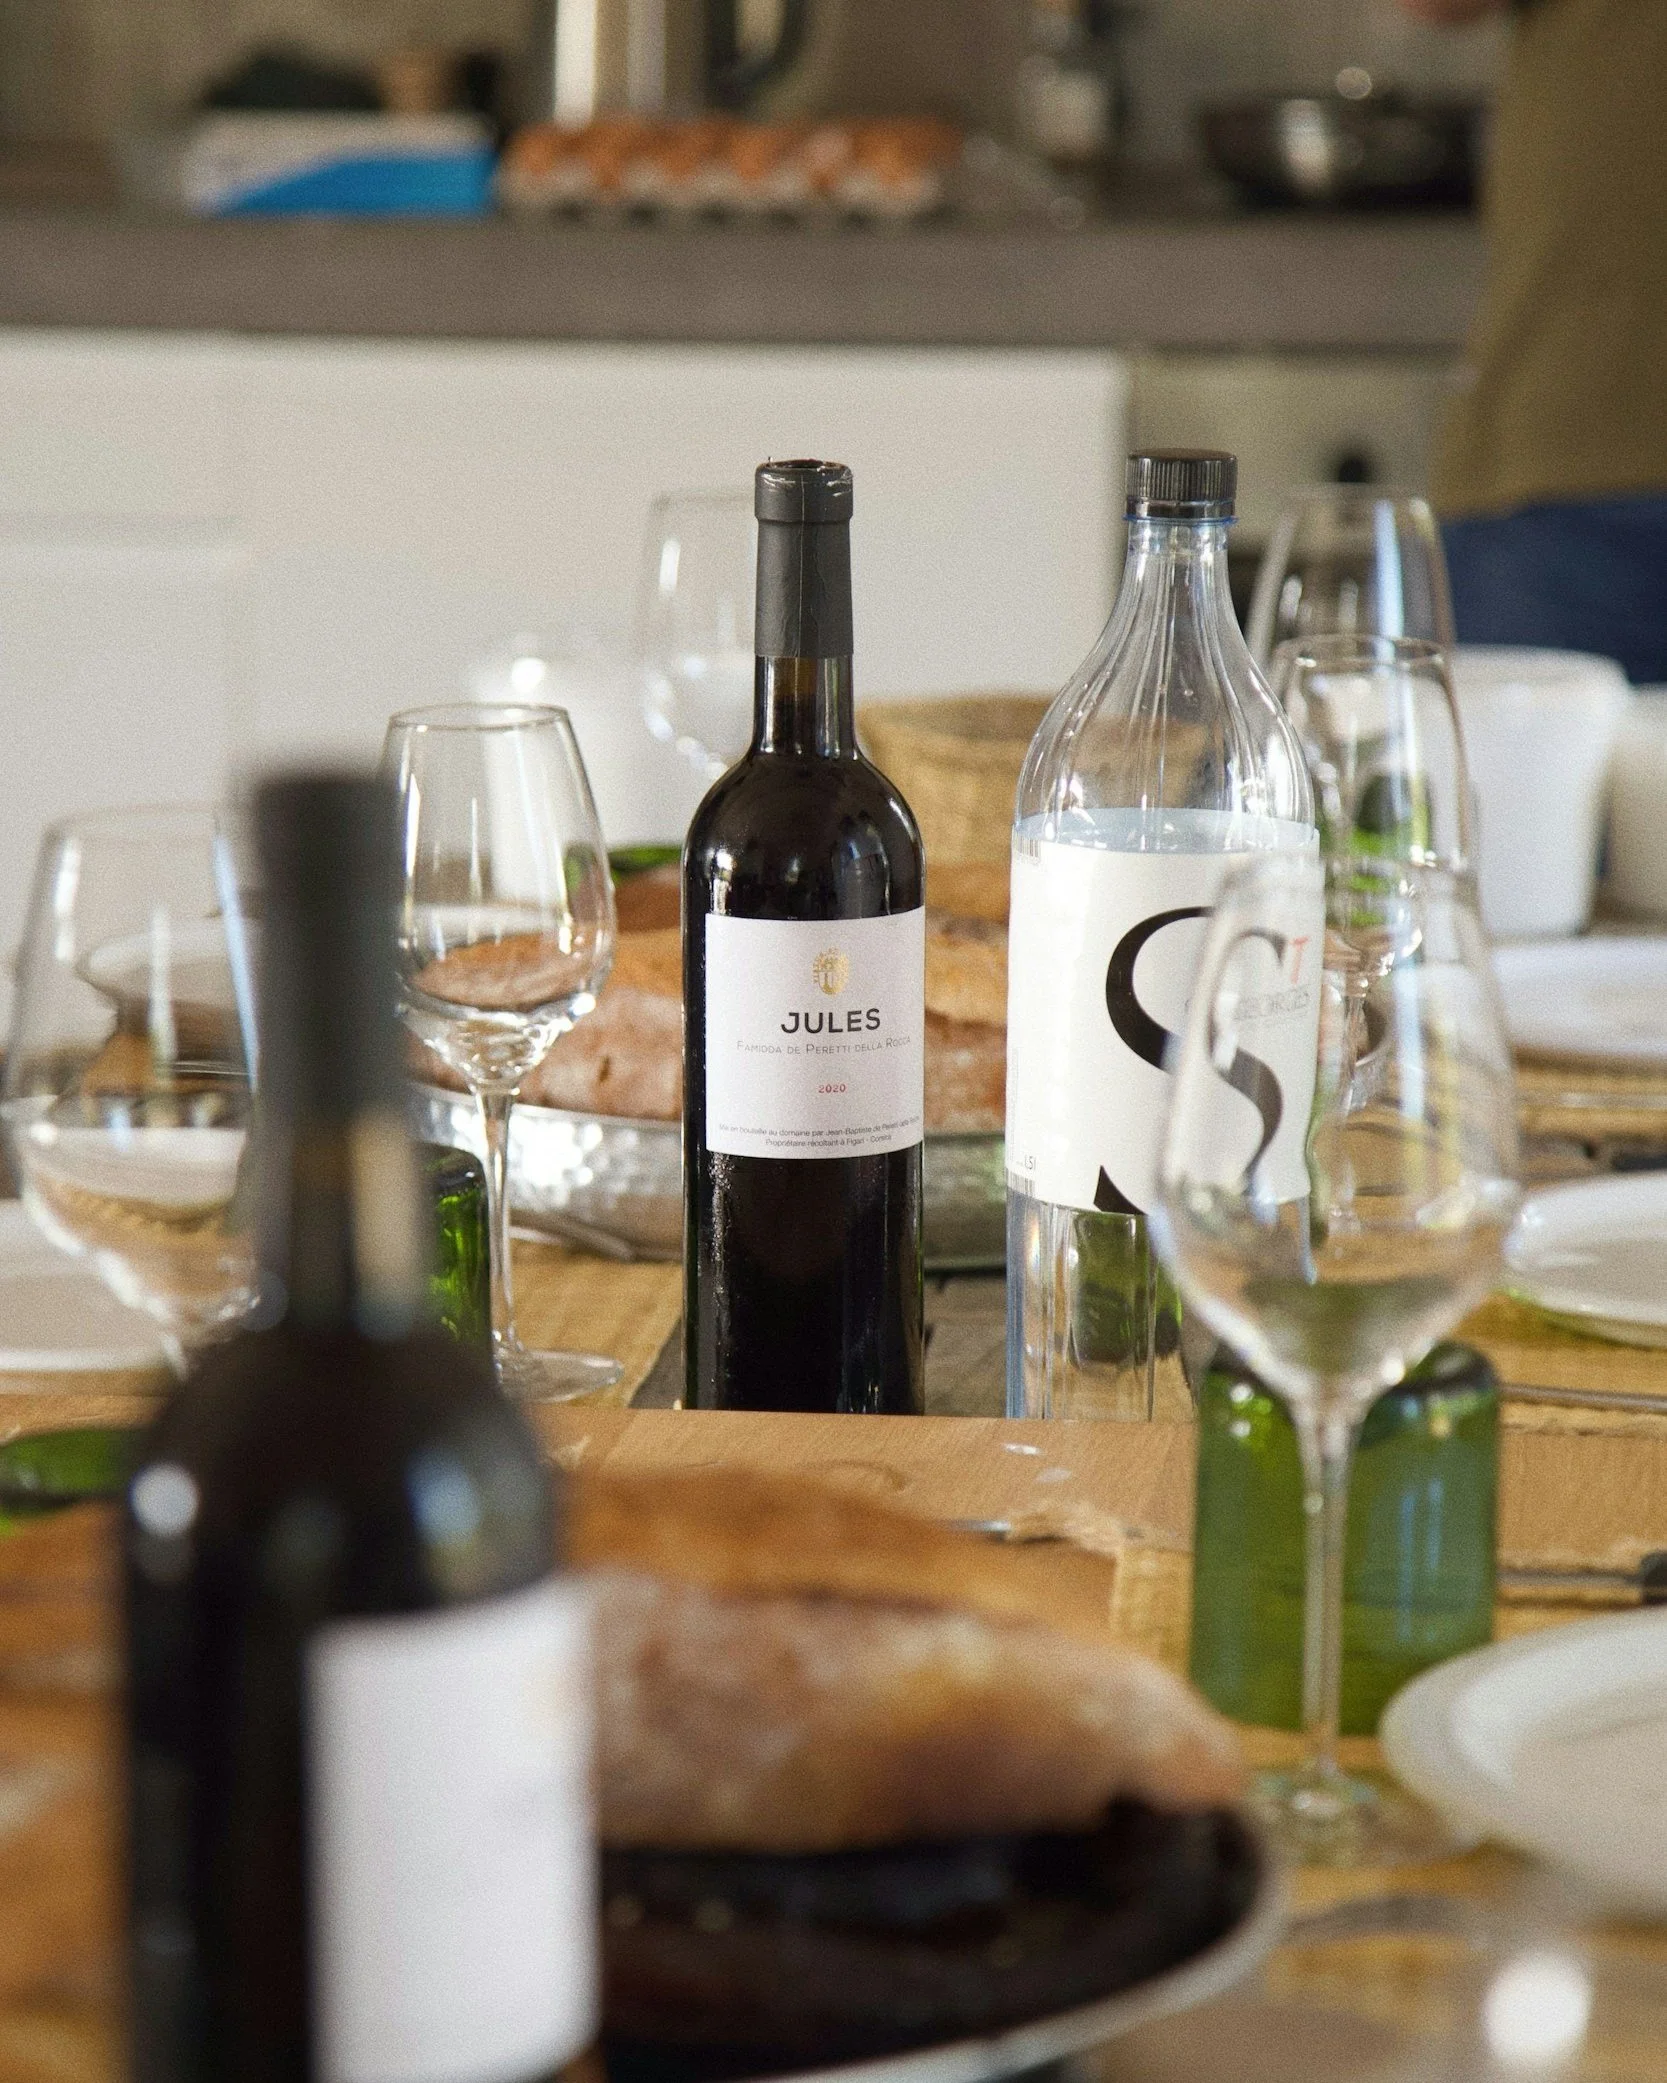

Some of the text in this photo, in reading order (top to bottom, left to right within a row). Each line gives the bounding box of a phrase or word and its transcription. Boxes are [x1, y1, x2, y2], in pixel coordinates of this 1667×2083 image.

[780, 1007, 881, 1034] JULES
[805, 1043, 850, 1055] PERETTI
[817, 1083, 847, 1094] 2020
[779, 1129, 810, 1138] domaine
